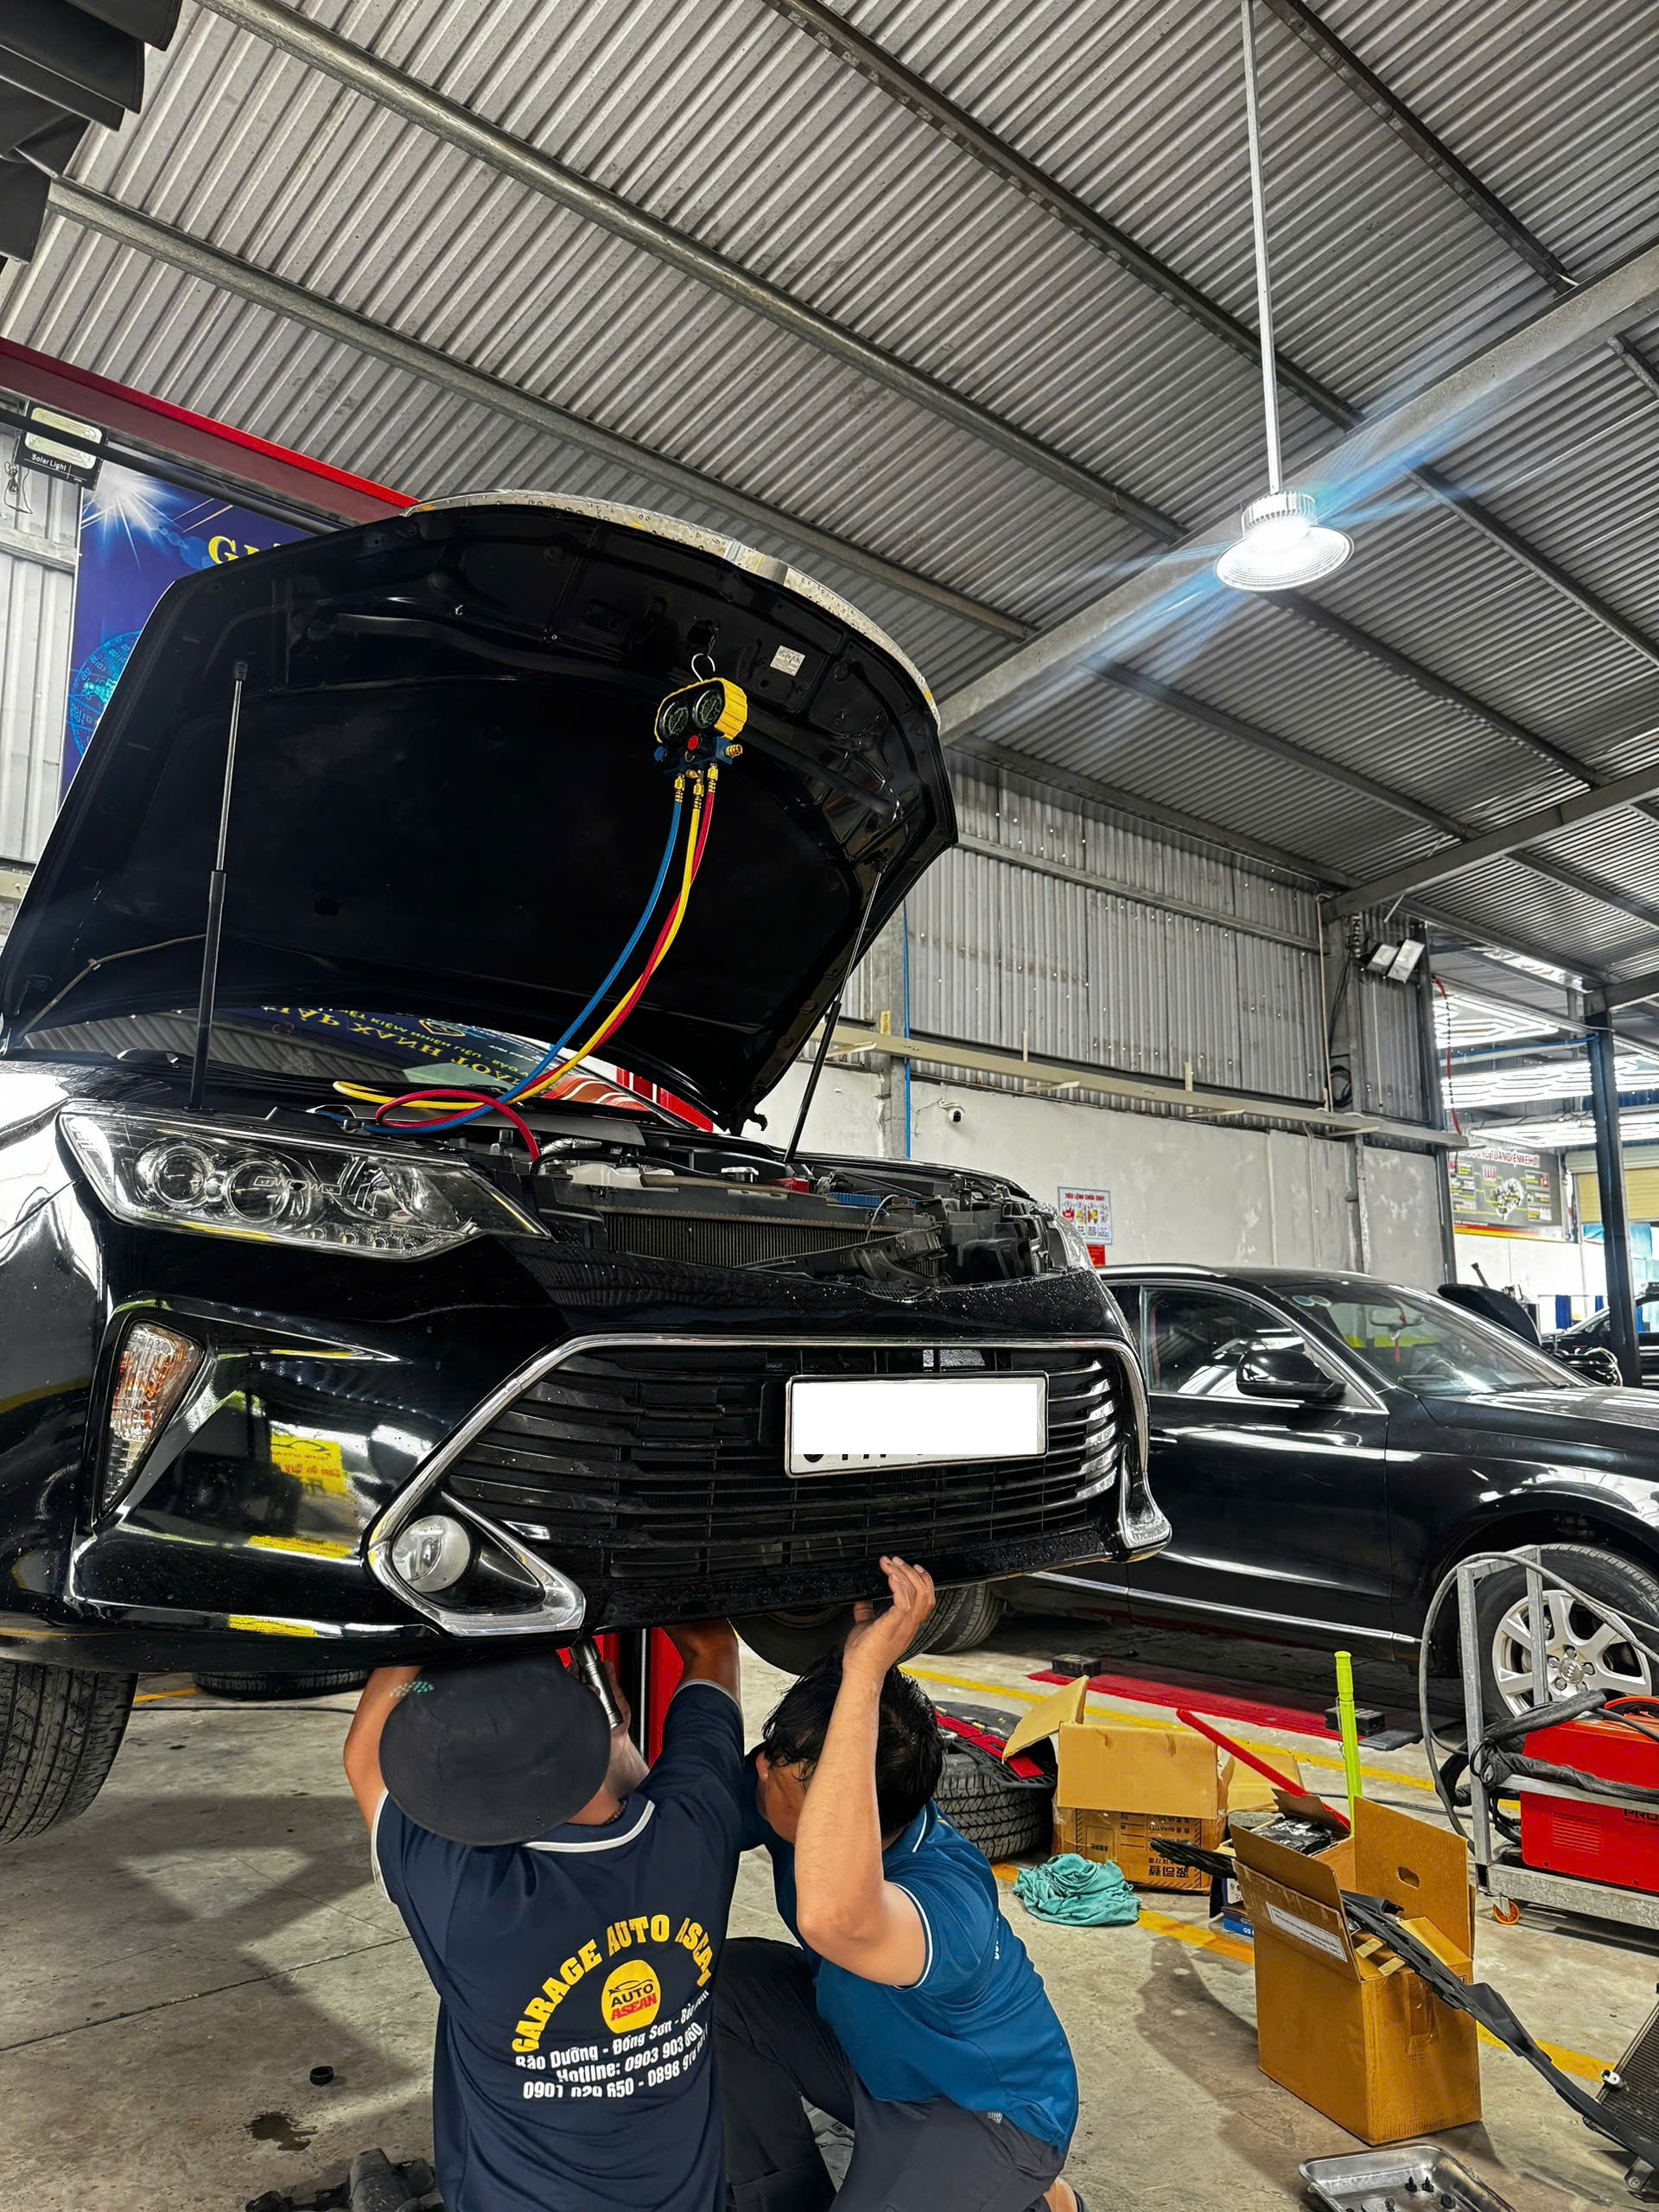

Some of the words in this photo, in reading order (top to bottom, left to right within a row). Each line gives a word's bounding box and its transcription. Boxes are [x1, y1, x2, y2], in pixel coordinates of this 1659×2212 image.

[31, 454, 49, 465] Solar
[49, 460, 67, 471] Light
[512, 1939, 603, 2052] GARAGE
[607, 1914, 671, 1957] AUTO
[610, 1983, 654, 2008] AUTO
[610, 1993, 658, 2021] ASEAN
[550, 2046, 598, 2069] Dưỡng
[649, 2020, 672, 2039] Sơn
[556, 2063, 621, 2082] Hotline:
[625, 2047, 659, 2072] 0903
[662, 2036, 684, 2059] 903
[523, 2082, 563, 2099] 0901
[647, 2060, 681, 2087] 0898
